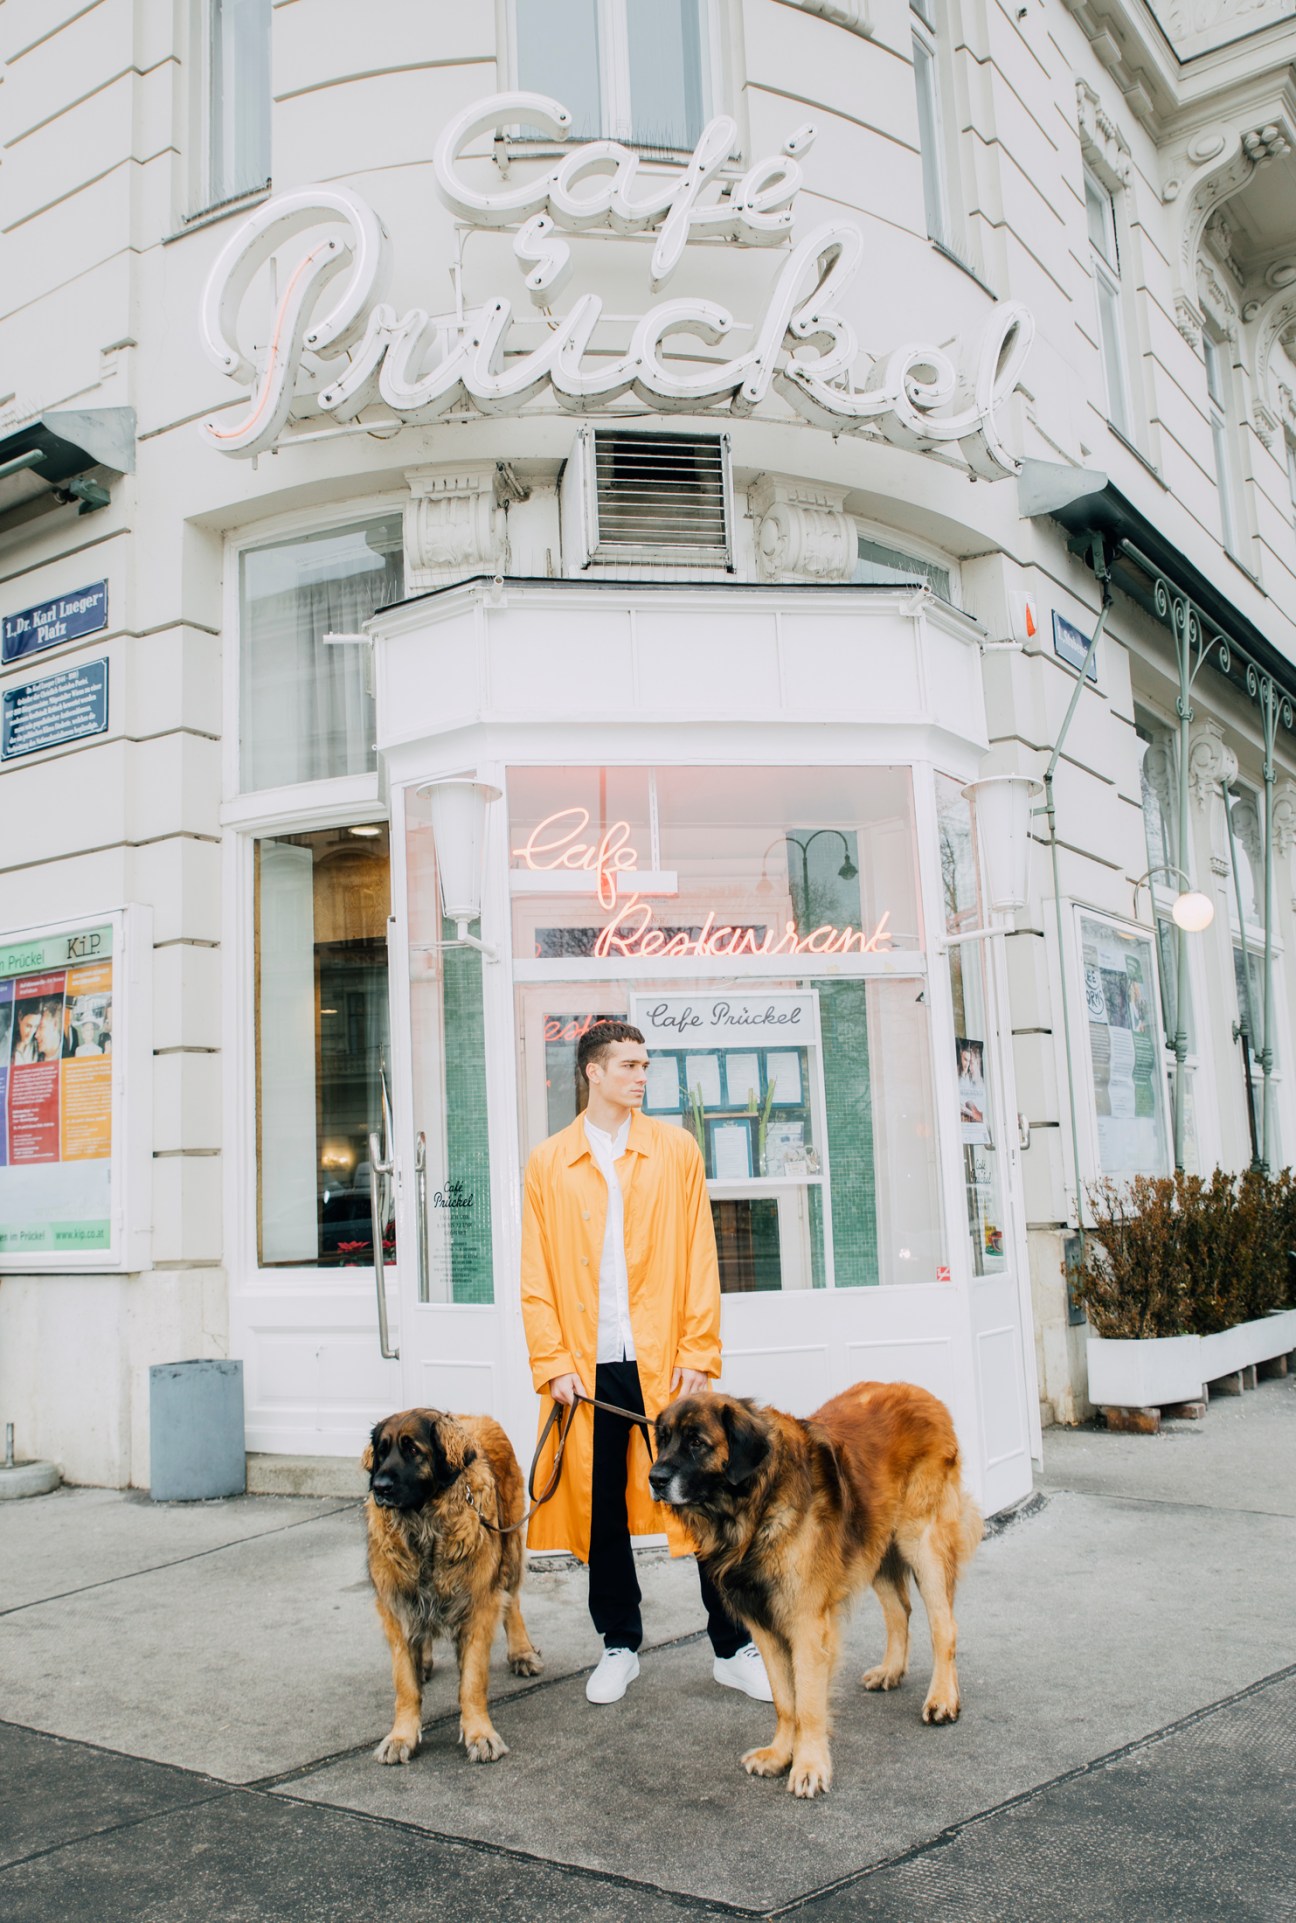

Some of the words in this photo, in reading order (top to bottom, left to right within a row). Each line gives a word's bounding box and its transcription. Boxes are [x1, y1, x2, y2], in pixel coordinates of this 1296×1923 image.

[434, 91, 818, 293] Café
[199, 183, 1037, 482] Prückel
[33, 607, 57, 629] Karl
[37, 621, 67, 643] Platz
[594, 892, 893, 958] Restaurant
[8, 948, 46, 970] Prückel
[646, 1003, 704, 1033] Cafe
[710, 1001, 802, 1026] Prückel
[443, 1180, 464, 1197] Café
[433, 1191, 474, 1209] Prückel
